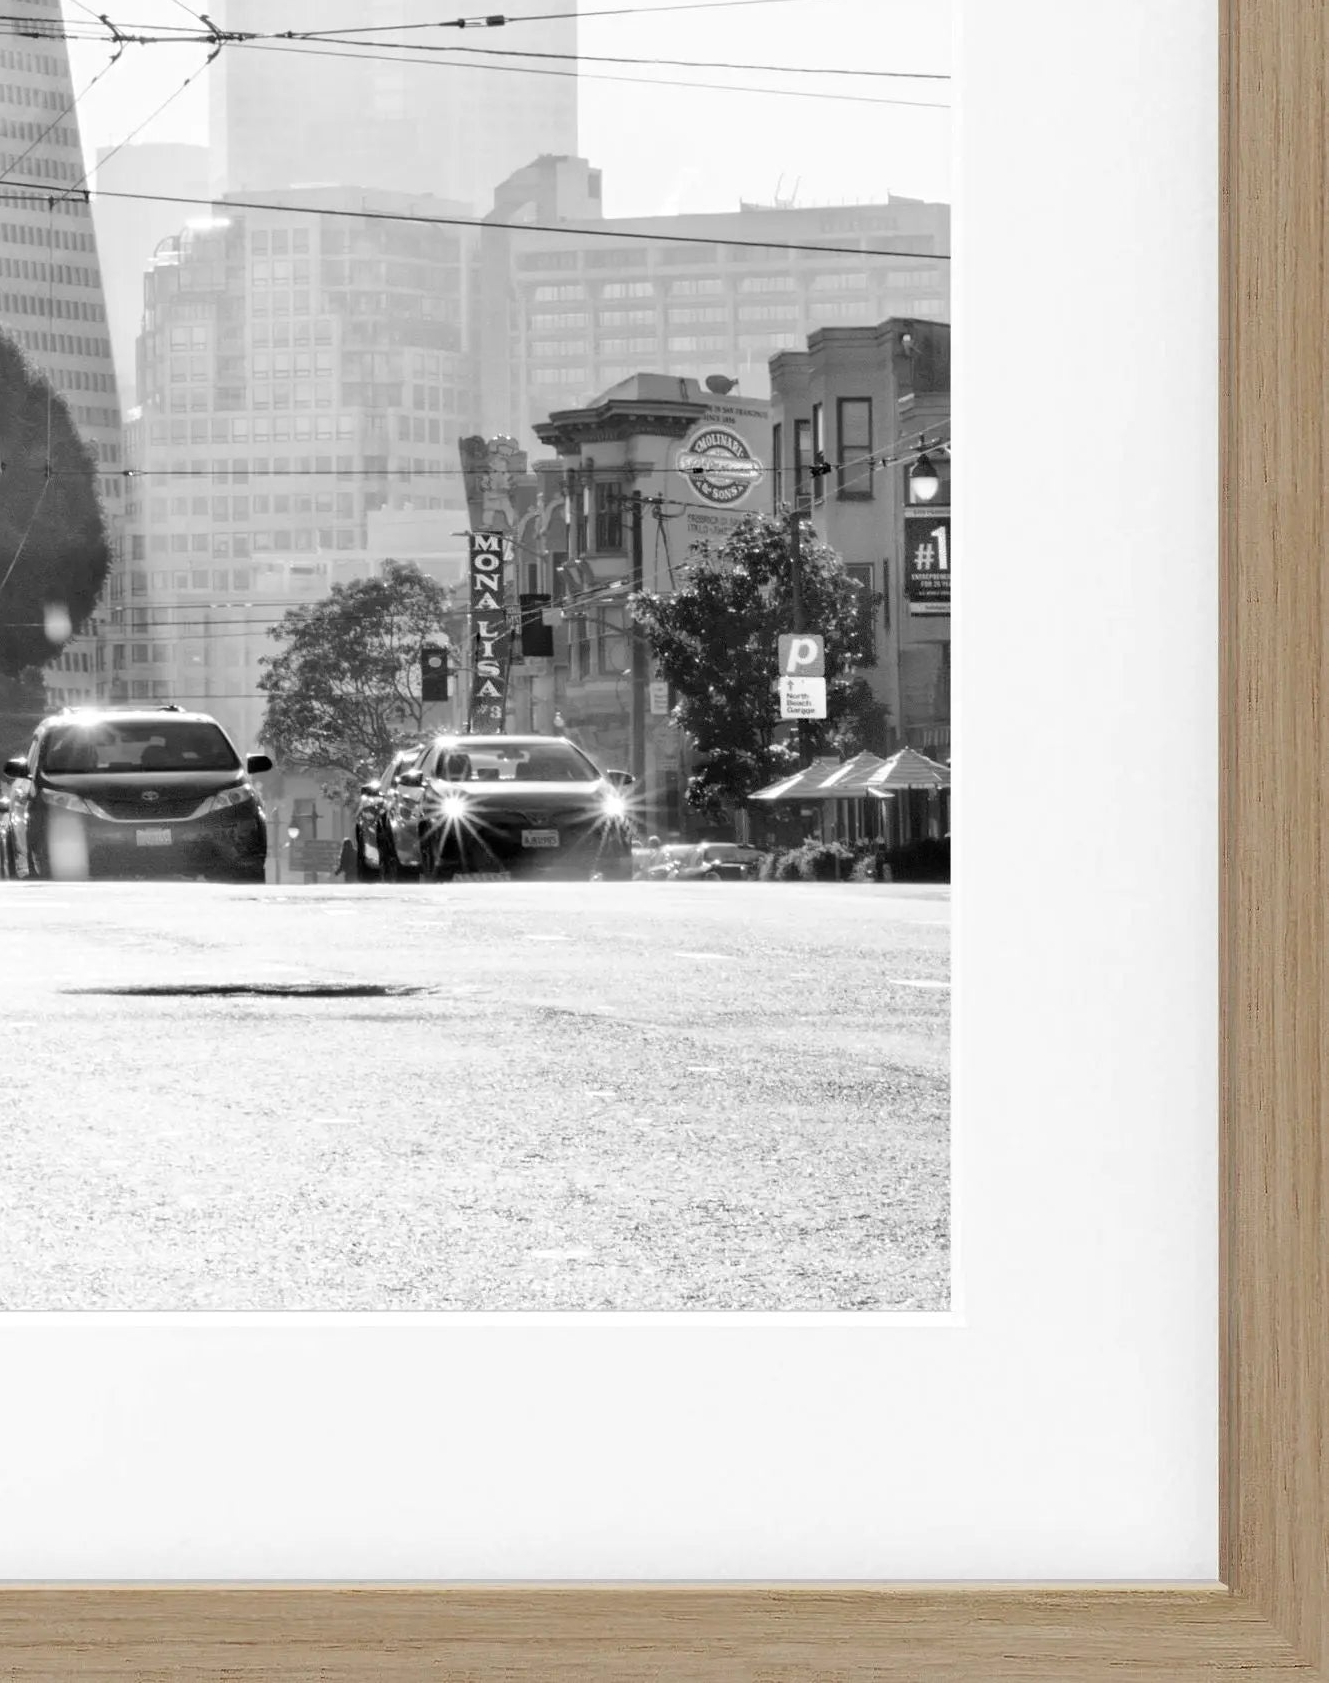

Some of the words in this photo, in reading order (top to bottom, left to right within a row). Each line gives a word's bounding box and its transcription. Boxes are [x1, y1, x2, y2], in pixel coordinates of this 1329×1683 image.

[698, 433, 743, 457] MOLINARI
[712, 485, 739, 500] SONS
[914, 525, 948, 570] #1
[474, 535, 501, 610] MONA
[477, 620, 503, 698] LISA
[786, 692, 809, 700] North
[786, 699, 812, 708] Beach
[786, 707, 816, 715] Garage
